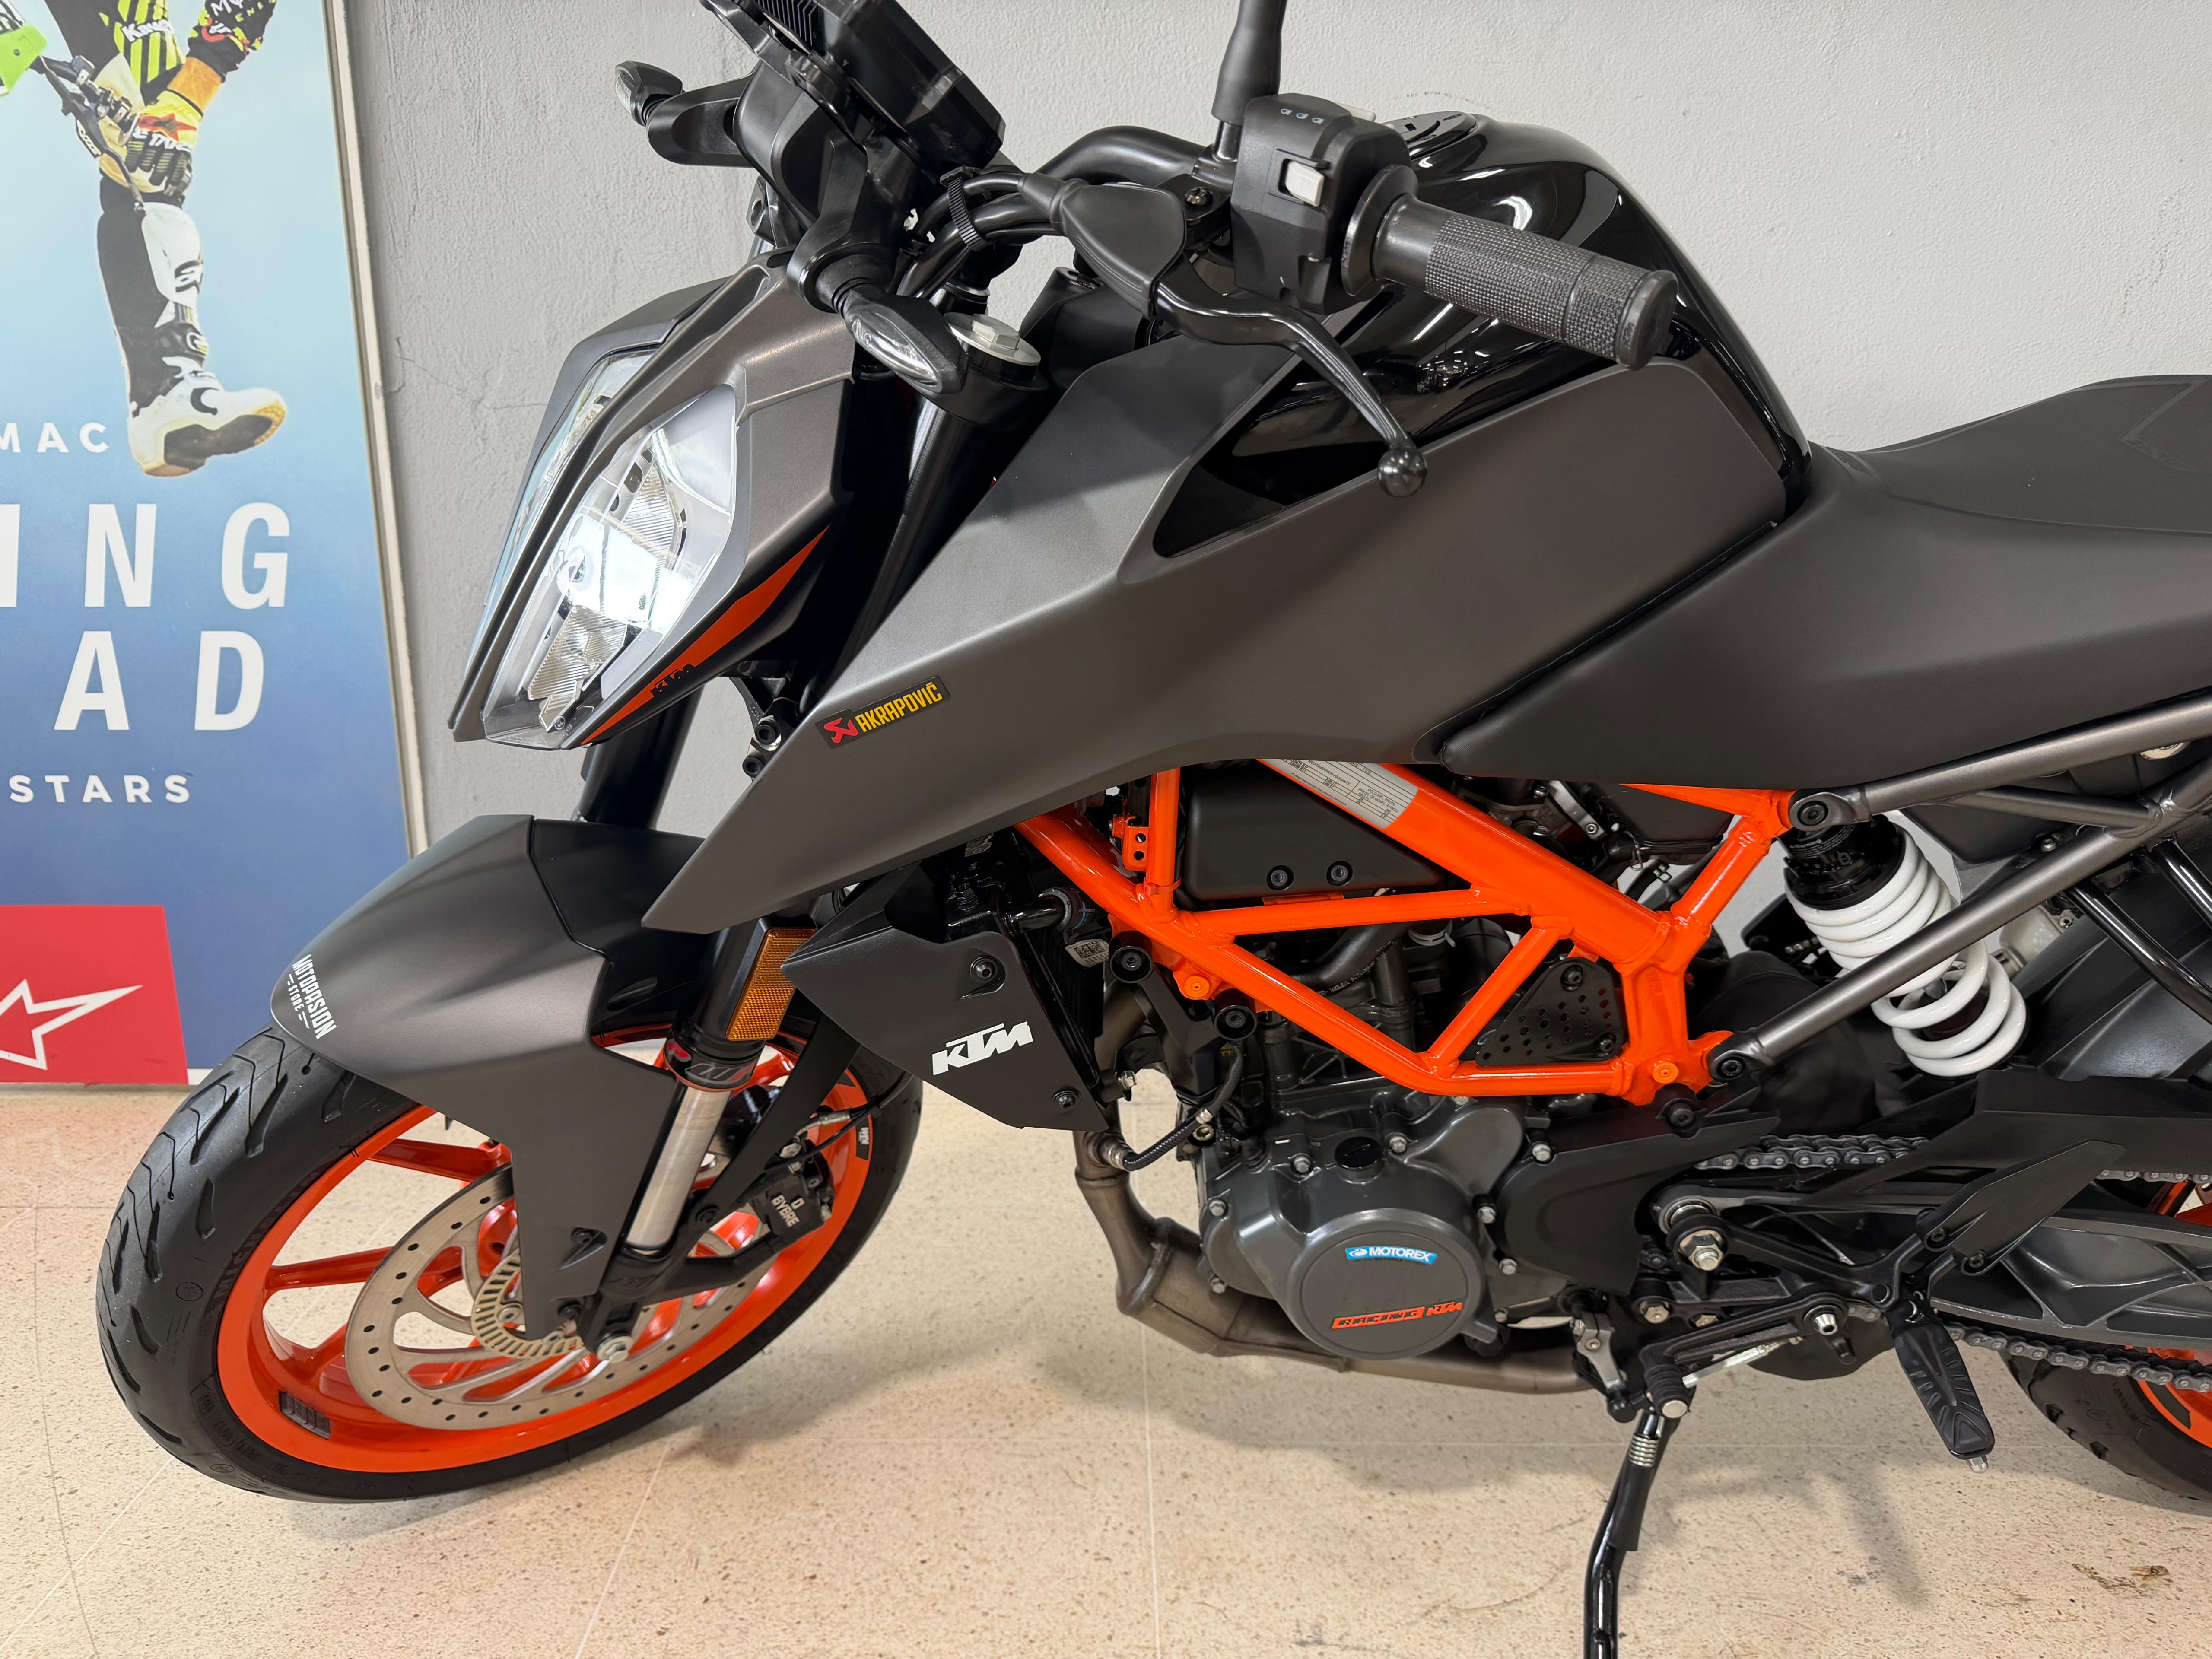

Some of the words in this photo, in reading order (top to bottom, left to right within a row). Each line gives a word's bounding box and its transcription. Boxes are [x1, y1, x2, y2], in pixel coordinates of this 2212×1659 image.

[0, 502, 290, 610] ING
[54, 631, 264, 731] AD
[9, 775, 191, 803] STARS
[288, 984, 305, 1012] STORE
[292, 954, 337, 1039] MOTOPASION
[932, 1021, 1033, 1075] KTM
[771, 1194, 800, 1227] BYBRE
[1368, 1246, 1433, 1262] MOTOREX
[1337, 1309, 1418, 1327] RACING
[1426, 1301, 1463, 1316] KTM
